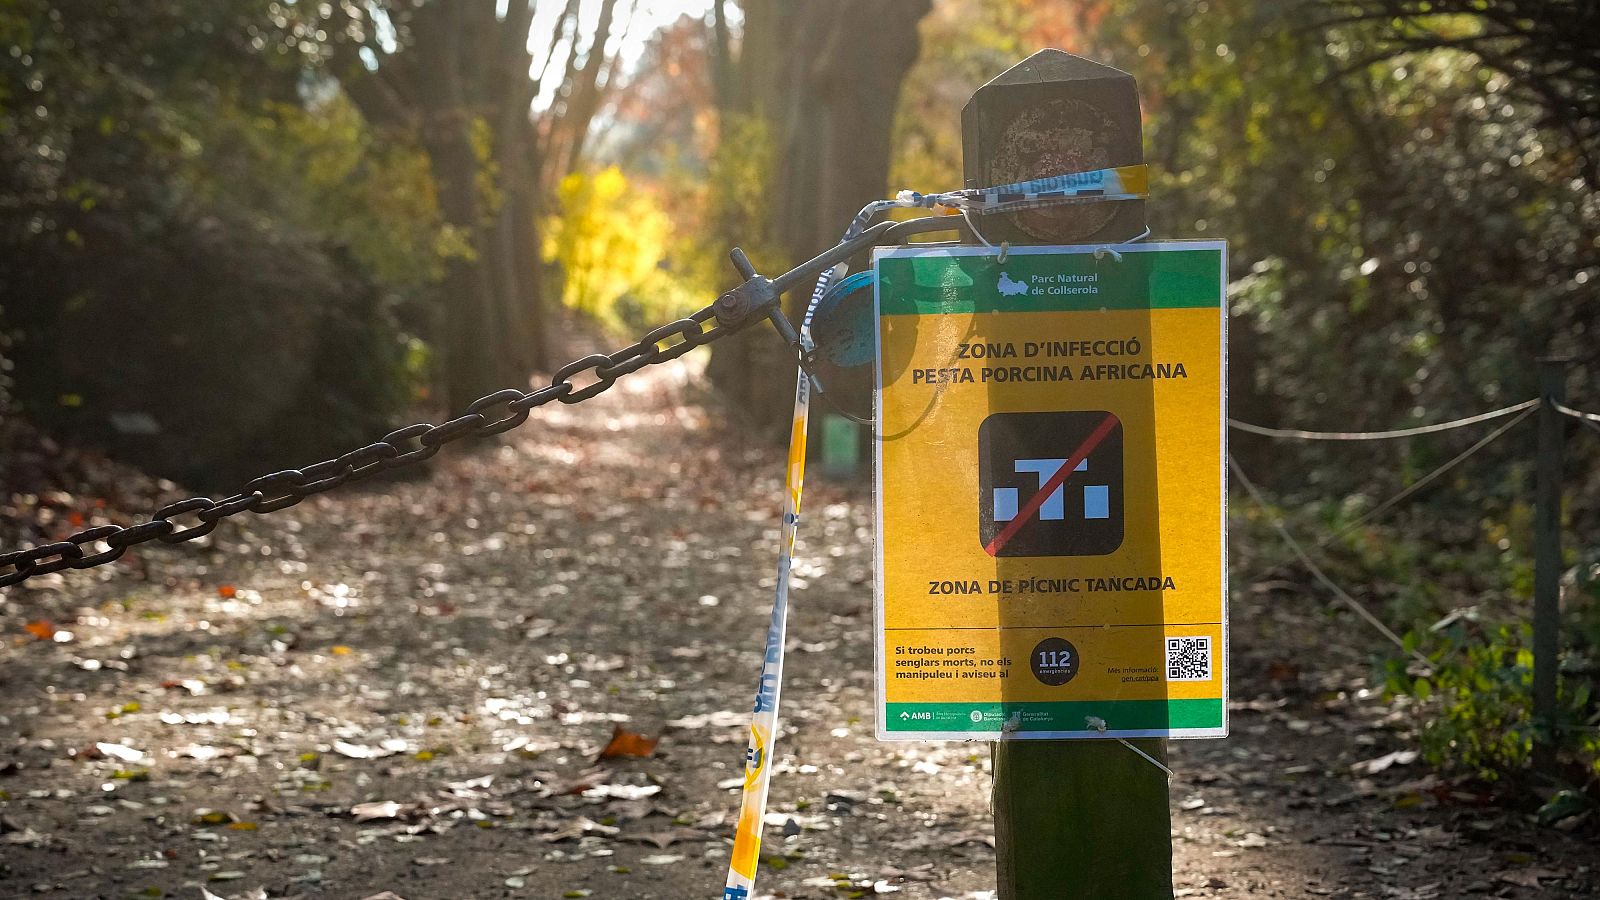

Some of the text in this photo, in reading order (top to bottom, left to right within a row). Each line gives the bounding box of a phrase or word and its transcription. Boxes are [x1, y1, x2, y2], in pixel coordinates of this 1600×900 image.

[1031, 273, 1098, 283] Parc Natural
[1031, 285, 1098, 295] de Collserola
[957, 342, 1018, 359] ZONA
[912, 363, 1188, 384] PESTA PORCINA AFRICANA
[928, 576, 1176, 595] ZONA DE PÍCNIC TANCADA
[895, 646, 976, 657] Si trobeu porcs
[895, 659, 940, 669] senglars
[942, 659, 977, 668] morts,
[997, 657, 1012, 666] els
[1039, 650, 1070, 667] 112
[895, 670, 1009, 680] manipuleu i aviseu al
[911, 712, 931, 720] AMB
